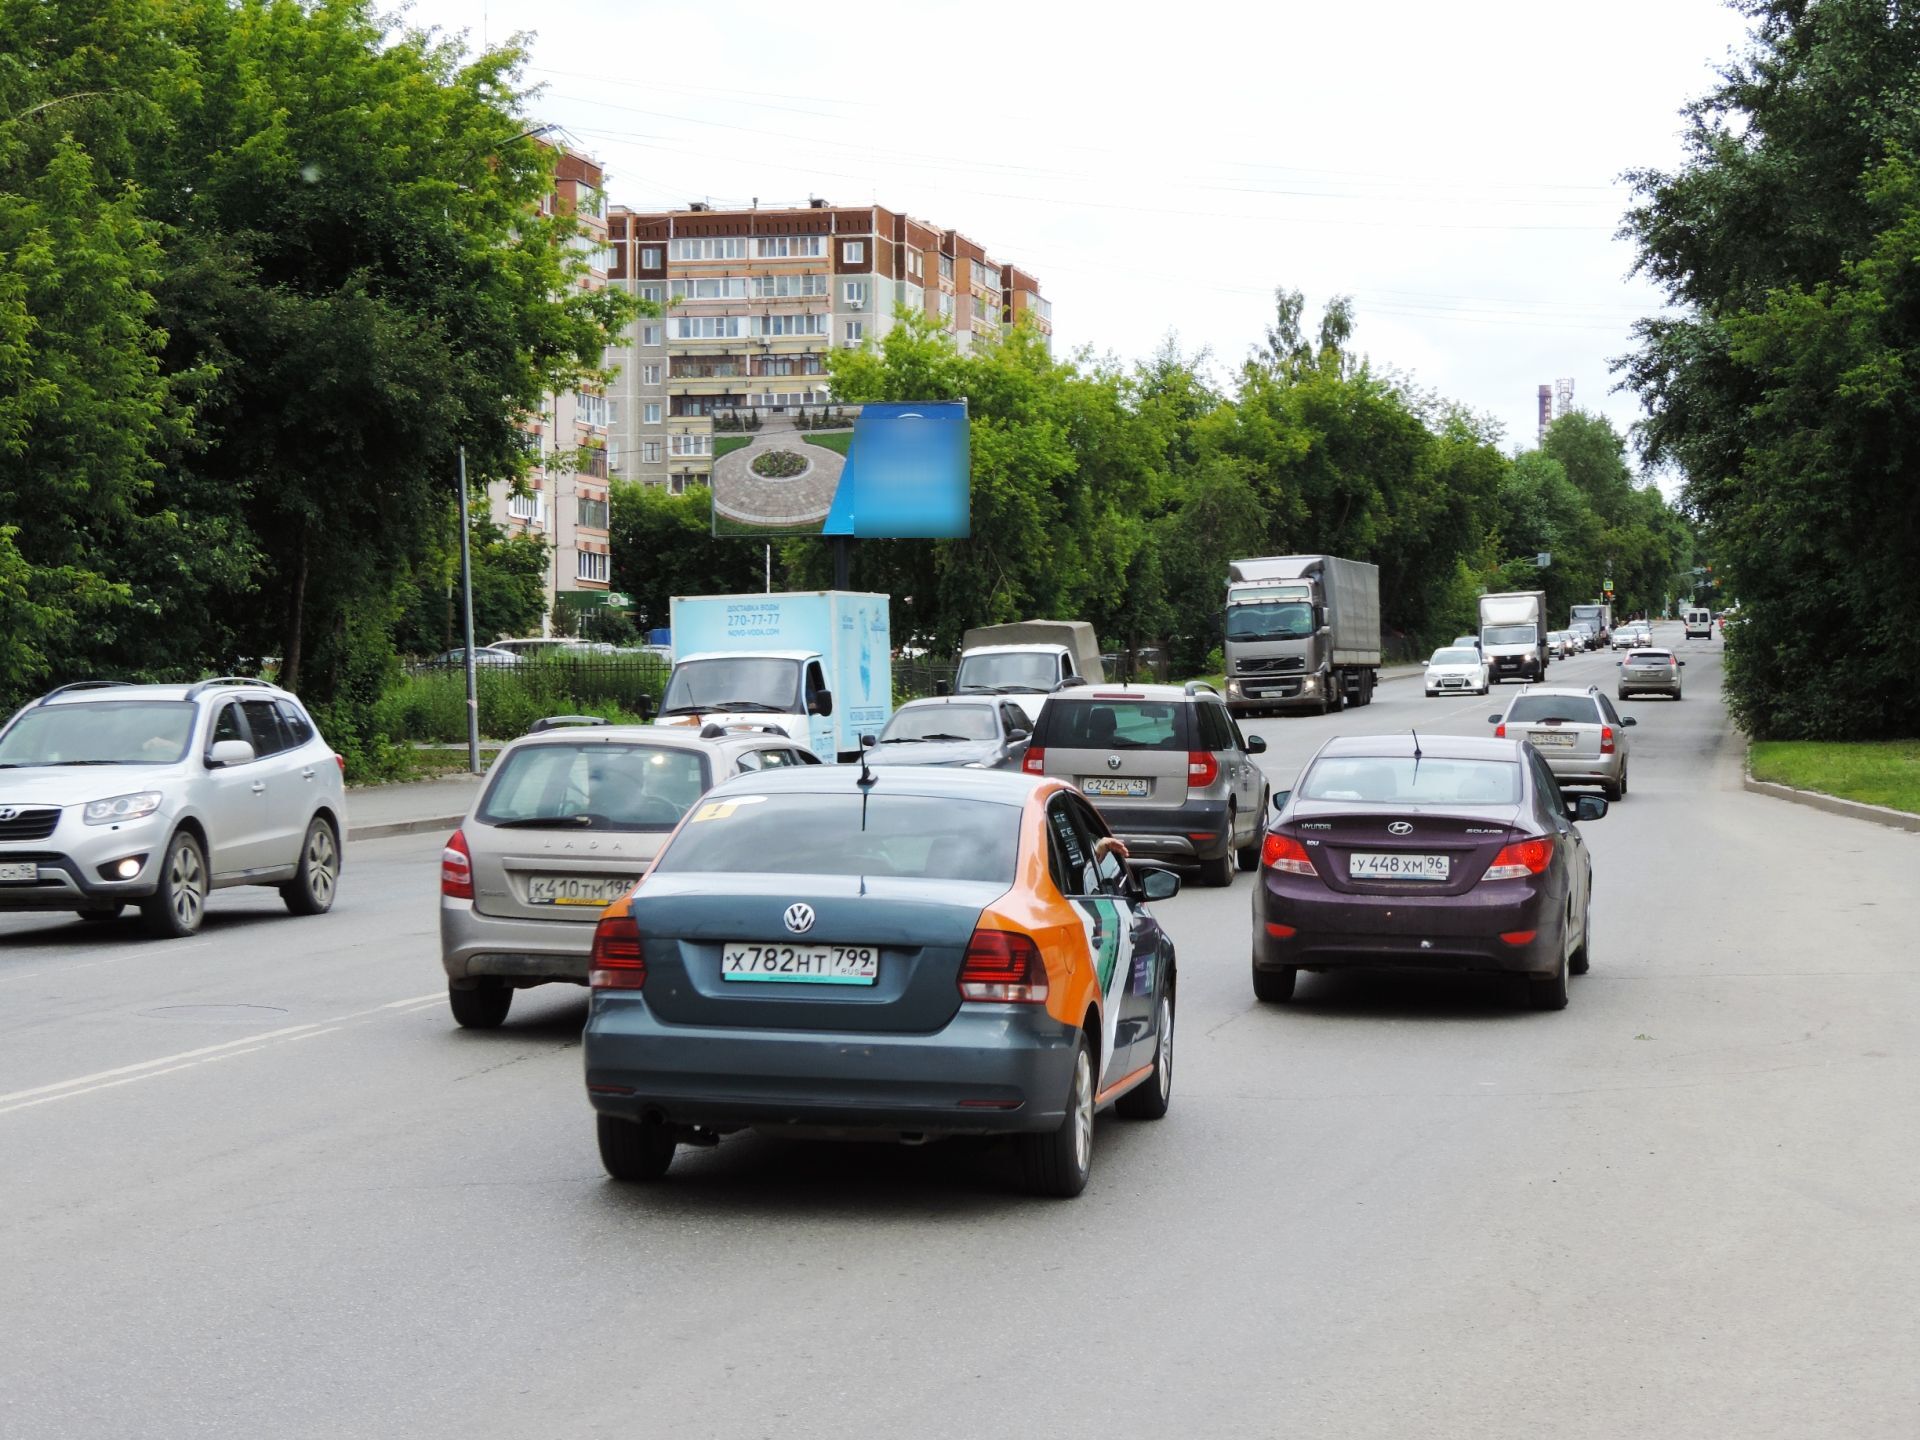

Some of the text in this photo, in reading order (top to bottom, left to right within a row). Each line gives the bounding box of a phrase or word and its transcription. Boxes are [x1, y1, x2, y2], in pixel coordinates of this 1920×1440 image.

[727, 603, 780, 612] ДОСТАВКА ВОДЫ
[727, 613, 780, 626] 270-77-77
[727, 628, 780, 637] NOVO-VODA.COM
[1087, 779, 1143, 791] С242НХ 43
[543, 840, 622, 850] LADA
[1427, 857, 1443, 869] 96
[533, 879, 605, 899] К410ТМ
[730, 947, 871, 974] Х782НТ 799
[840, 967, 860, 976] RUS
